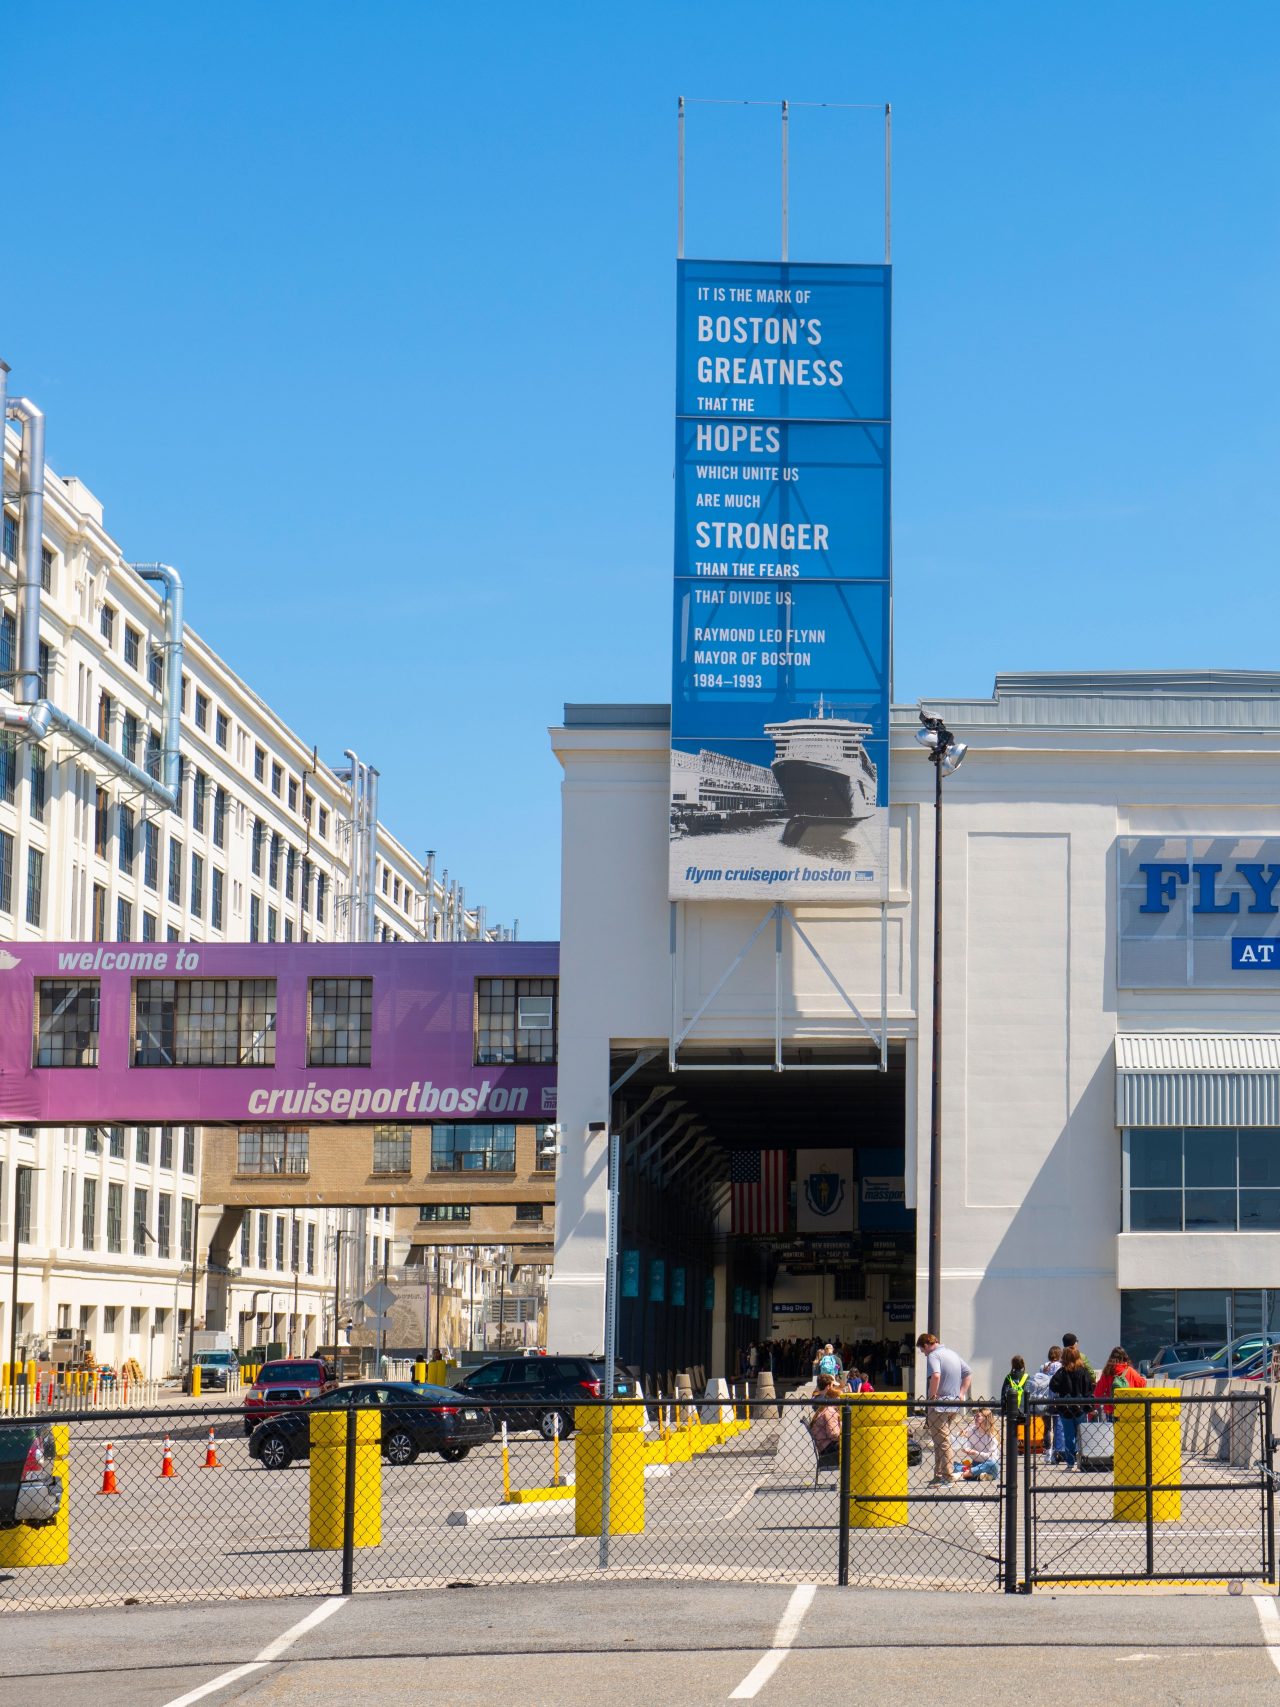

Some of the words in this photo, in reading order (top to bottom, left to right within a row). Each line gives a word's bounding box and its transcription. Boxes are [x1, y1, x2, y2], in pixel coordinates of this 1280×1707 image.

[698, 287, 710, 301] IT
[713, 288, 726, 302] IS
[729, 288, 752, 303] THE
[756, 289, 791, 304] MARK
[795, 290, 811, 304] OF
[698, 315, 822, 345] BOSTON'S
[697, 356, 843, 386] GREATNESS
[697, 397, 727, 411] THAT
[732, 398, 754, 412] THE
[696, 424, 780, 453] HOPES
[696, 465, 738, 480] WHICH
[742, 466, 779, 481] UNITE
[783, 467, 799, 481] US
[696, 493, 721, 507] ARE
[724, 494, 760, 508] MUCH
[695, 521, 829, 550] STRONGER
[696, 562, 728, 576] THAN
[731, 563, 755, 577] THE
[759, 563, 800, 577] FEARS
[695, 590, 726, 603] THAT
[729, 590, 771, 604] DIVIDE
[775, 591, 796, 605] US.
[694, 628, 755, 642] RAYMOND
[759, 629, 783, 643] LEO
[787, 629, 826, 643] FLYNN
[694, 650, 737, 665] MAYOR
[741, 651, 757, 665] OF
[761, 652, 811, 666] BOSTON
[685, 866, 722, 884] flynn
[724, 867, 800, 885] cruiseport
[802, 867, 852, 882] boston
[58, 948, 168, 971] welcome
[174, 949, 199, 971] to
[1238, 944, 1276, 963] AT
[247, 1081, 529, 1119] cruiseportboston
[781, 1304, 794, 1312] Bag
[795, 1304, 811, 1312] Drop
